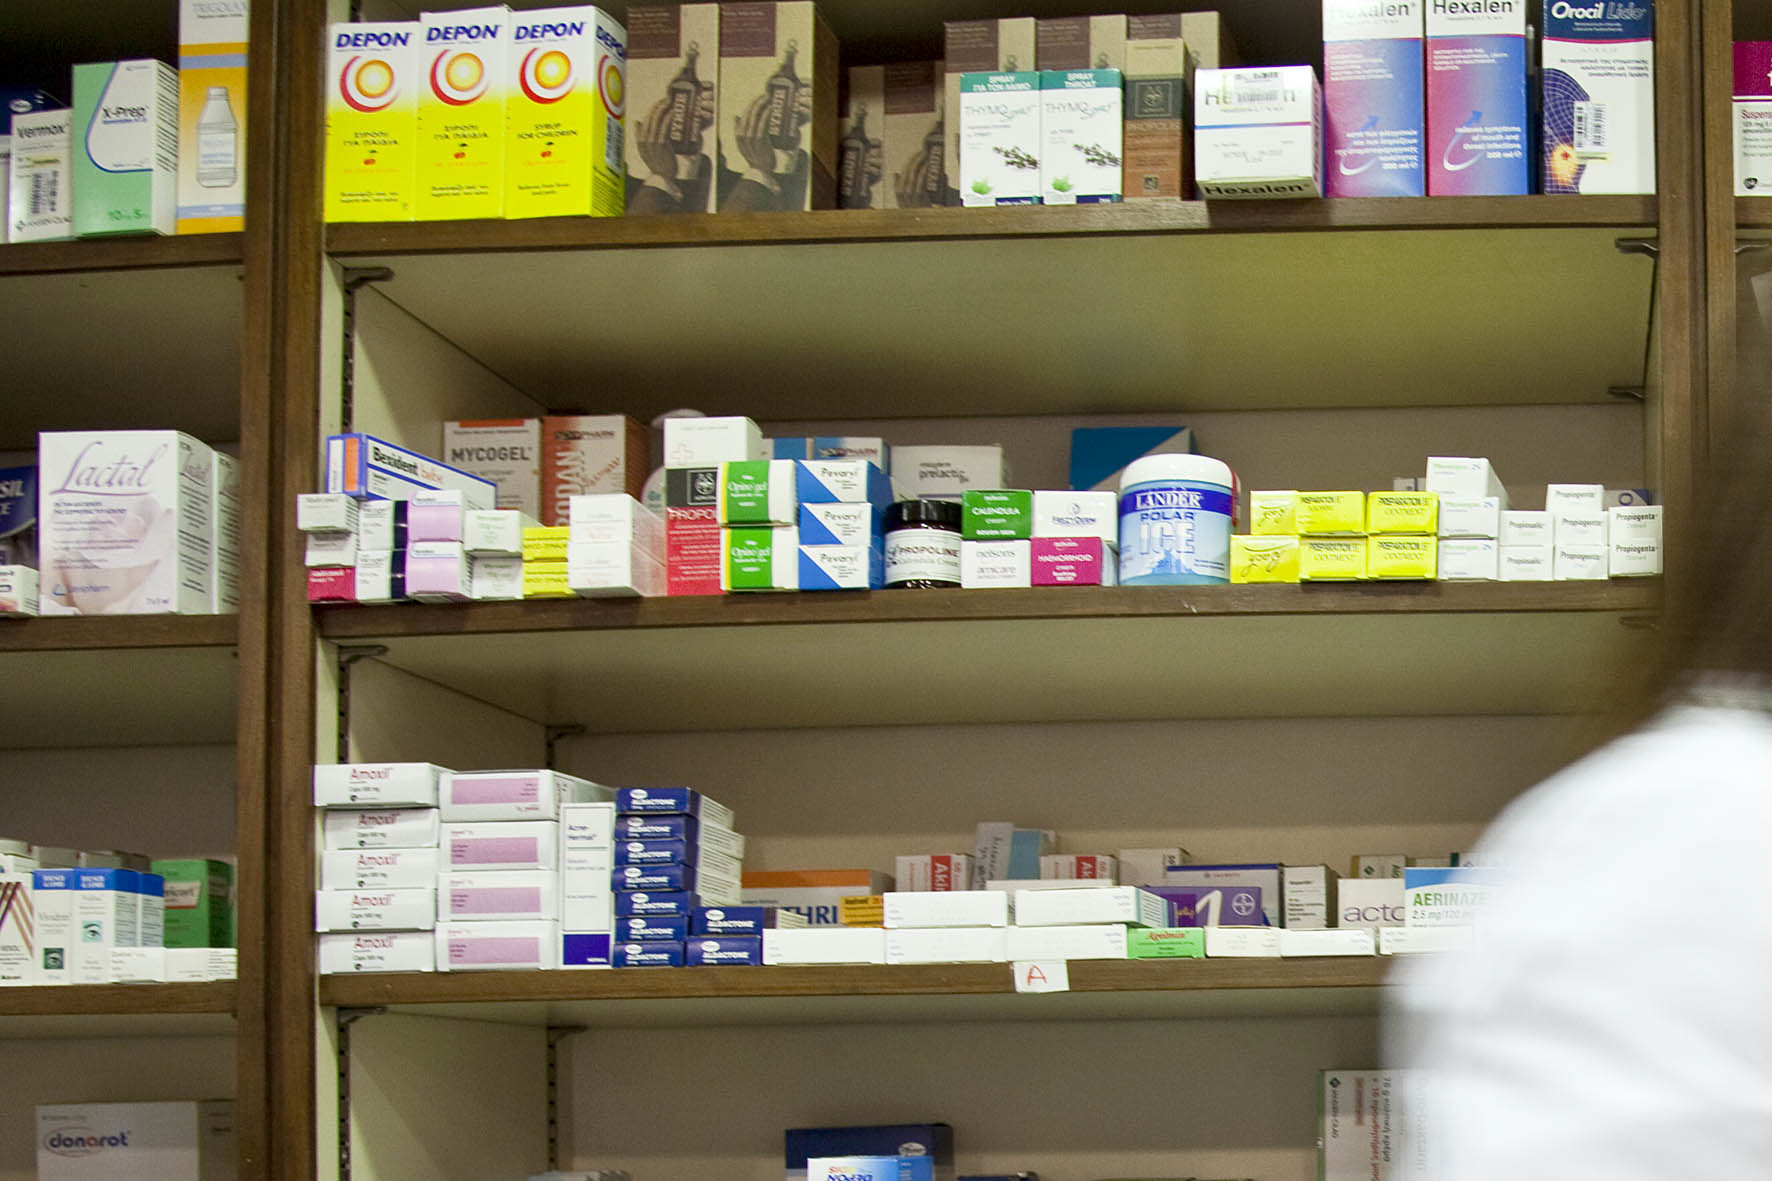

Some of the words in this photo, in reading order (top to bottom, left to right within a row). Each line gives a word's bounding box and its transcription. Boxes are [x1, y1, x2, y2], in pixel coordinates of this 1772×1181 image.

[1432, 0, 1513, 15] Hexalen
[1551, 1, 1603, 20] Orocil
[425, 25, 499, 44] DEPON
[513, 22, 585, 42] DEPON
[335, 32, 410, 50] DEPON
[451, 446, 528, 462] MYCOGEL
[1136, 491, 1201, 508] LANDER
[1139, 511, 1195, 522] POLAR
[1137, 523, 1196, 557] ICE
[351, 768, 390, 781] Amoxil
[359, 813, 396, 826] Amoxil
[1027, 965, 1047, 985] A
[50, 1132, 128, 1148] donarot
